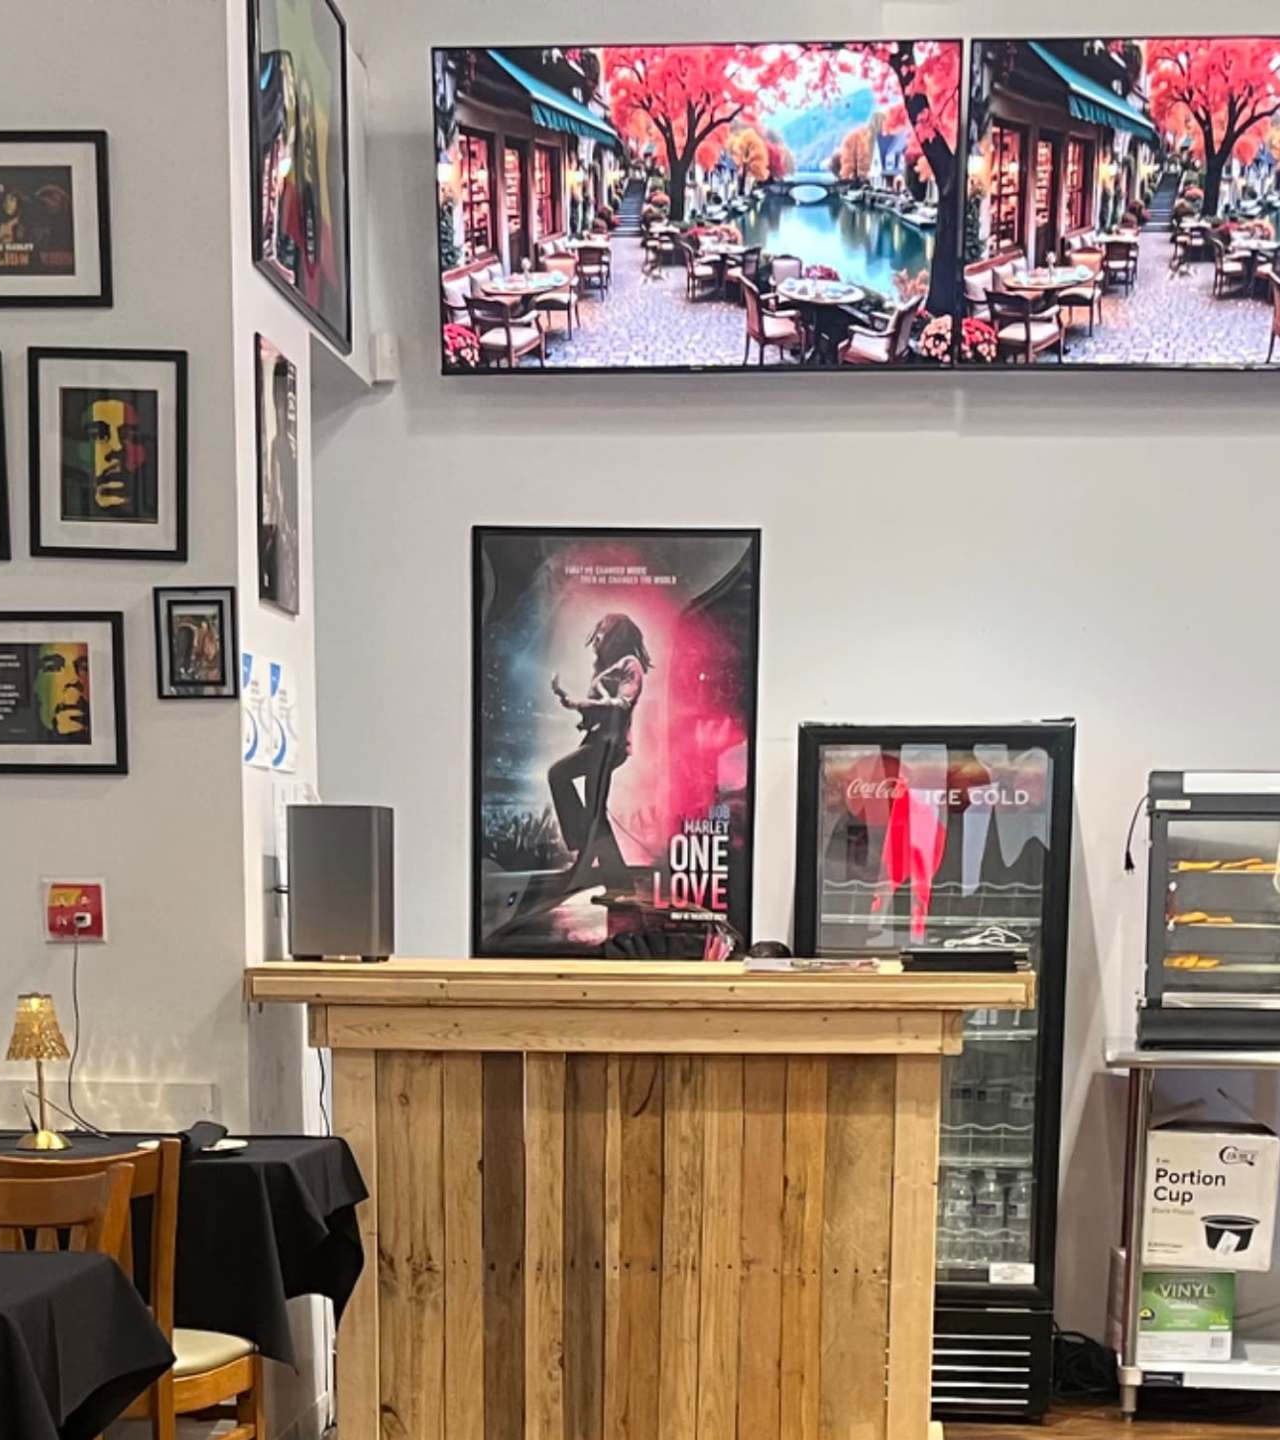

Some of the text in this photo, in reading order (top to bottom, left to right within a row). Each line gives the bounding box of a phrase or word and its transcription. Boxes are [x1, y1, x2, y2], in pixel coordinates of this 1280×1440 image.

[924, 788, 962, 806] ICE
[968, 788, 1030, 806] COLD
[684, 819, 730, 835] MARLEY
[669, 834, 729, 872] ONE
[653, 871, 728, 910] LOVE
[1154, 1167, 1226, 1188] Portion
[1153, 1185, 1194, 1207] Cup
[1160, 1283, 1213, 1299] VINYL
